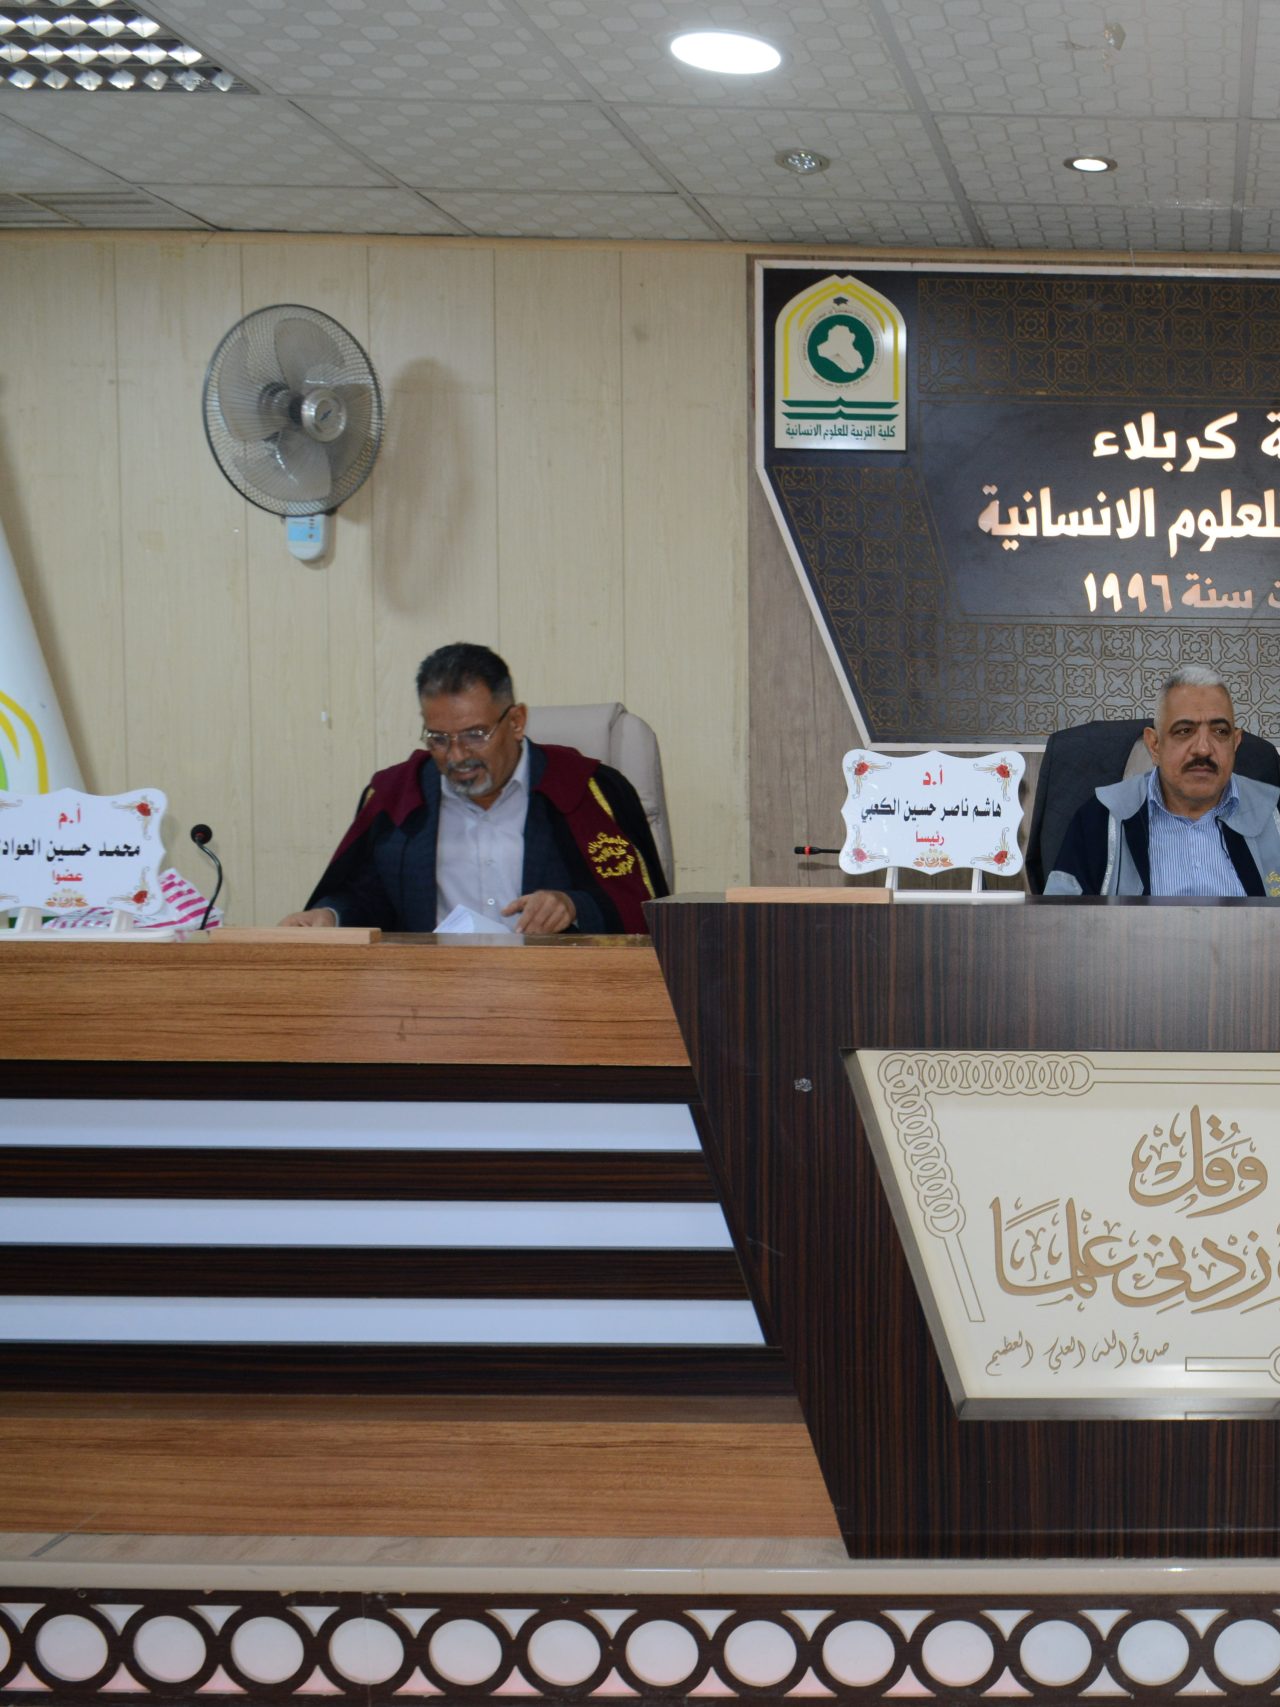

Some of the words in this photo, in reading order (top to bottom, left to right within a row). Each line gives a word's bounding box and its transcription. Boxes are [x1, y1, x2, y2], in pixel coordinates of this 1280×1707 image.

[786, 423, 822, 439] الانسانية
[823, 424, 848, 440] للعلوم
[850, 424, 876, 440] التربية
[878, 424, 896, 440] كلية
[1094, 412, 1238, 472] كربلاء
[978, 484, 1155, 552] الانسانية
[1084, 572, 1173, 613] ١٩٩٦
[1182, 572, 1253, 610] سنة
[861, 797, 900, 823] الكعبي
[903, 800, 936, 822] حسين
[940, 799, 969, 821] ناصر
[972, 797, 1002, 822] هاشم
[0, 838, 41, 861] العواد
[46, 840, 91, 862] حسين
[98, 841, 140, 856] محمد
[985, 1330, 1034, 1376] العظيم
[1043, 1335, 1086, 1374] العلي
[1092, 1328, 1128, 1370] الله
[1130, 1331, 1170, 1364] صدق
